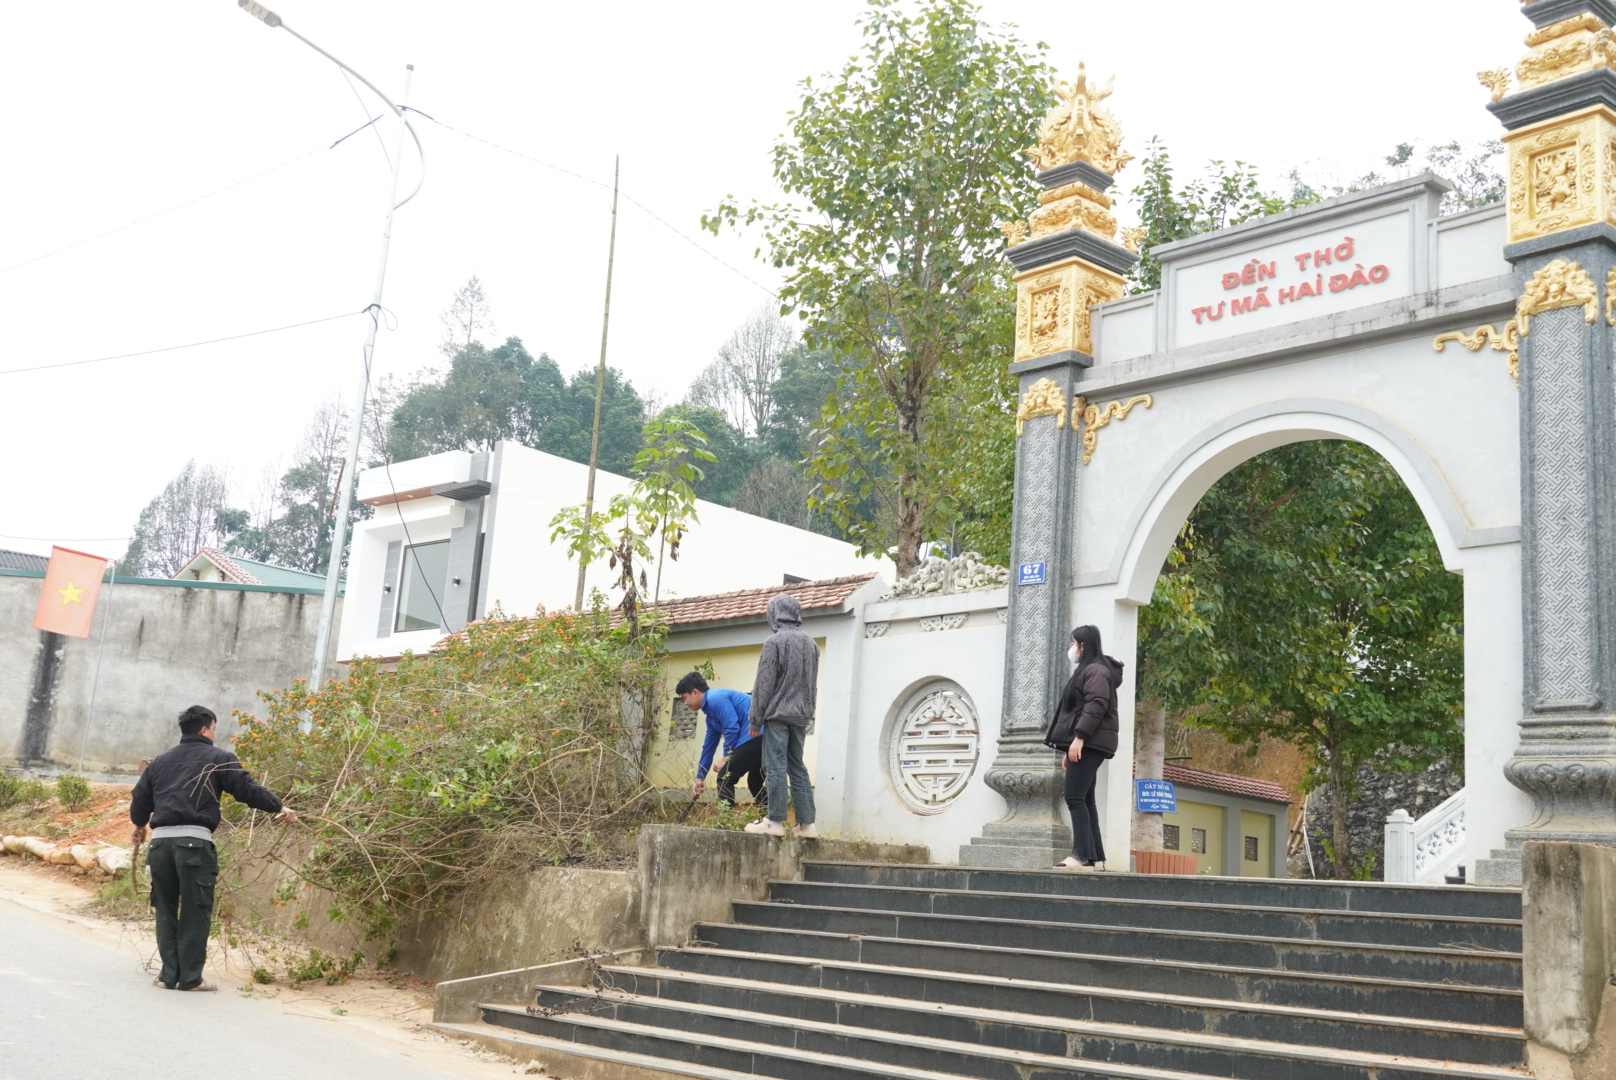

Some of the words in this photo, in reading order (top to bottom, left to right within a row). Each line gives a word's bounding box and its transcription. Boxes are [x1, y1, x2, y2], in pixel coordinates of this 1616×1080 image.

[1221, 258, 1276, 290] ĐỀN
[1294, 236, 1355, 270] THỜ
[1191, 300, 1225, 324] TƯ
[1231, 286, 1272, 315] MÃ
[1328, 263, 1390, 293] ĐÀO
[1023, 563, 1041, 575] 67
